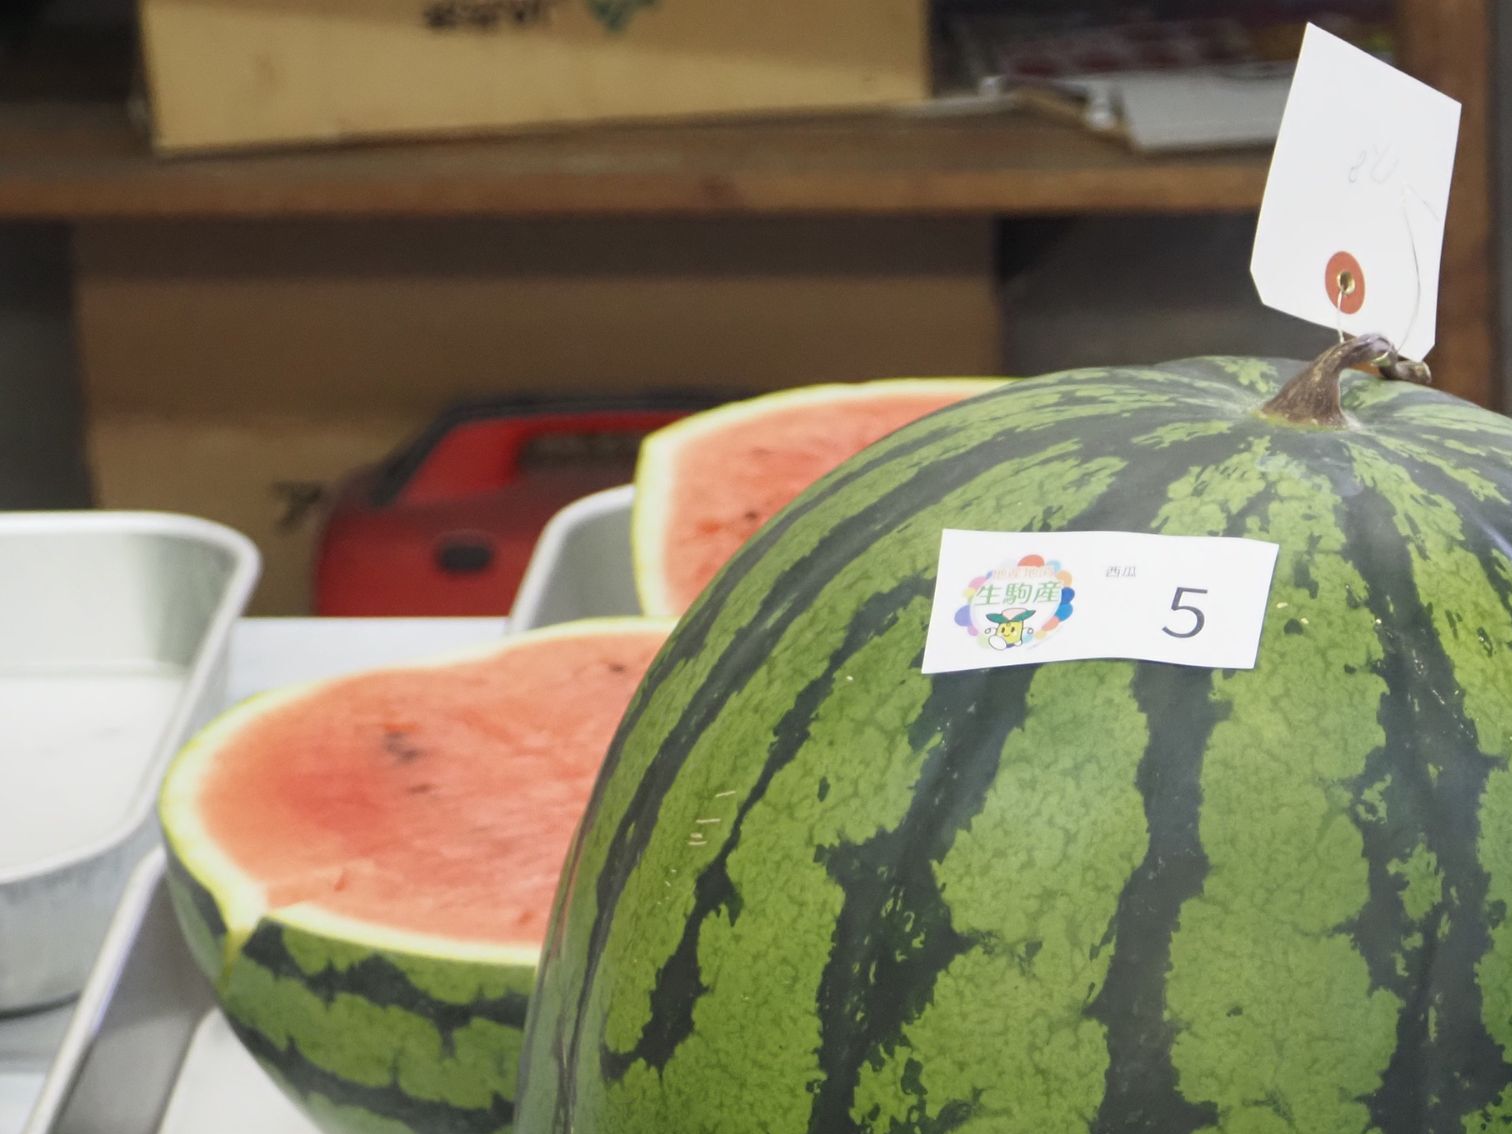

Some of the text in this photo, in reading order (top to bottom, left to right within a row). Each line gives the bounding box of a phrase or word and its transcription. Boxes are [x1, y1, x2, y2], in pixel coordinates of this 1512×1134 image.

[975, 580, 1063, 607] 生駒産
[1161, 586, 1208, 639] 5
